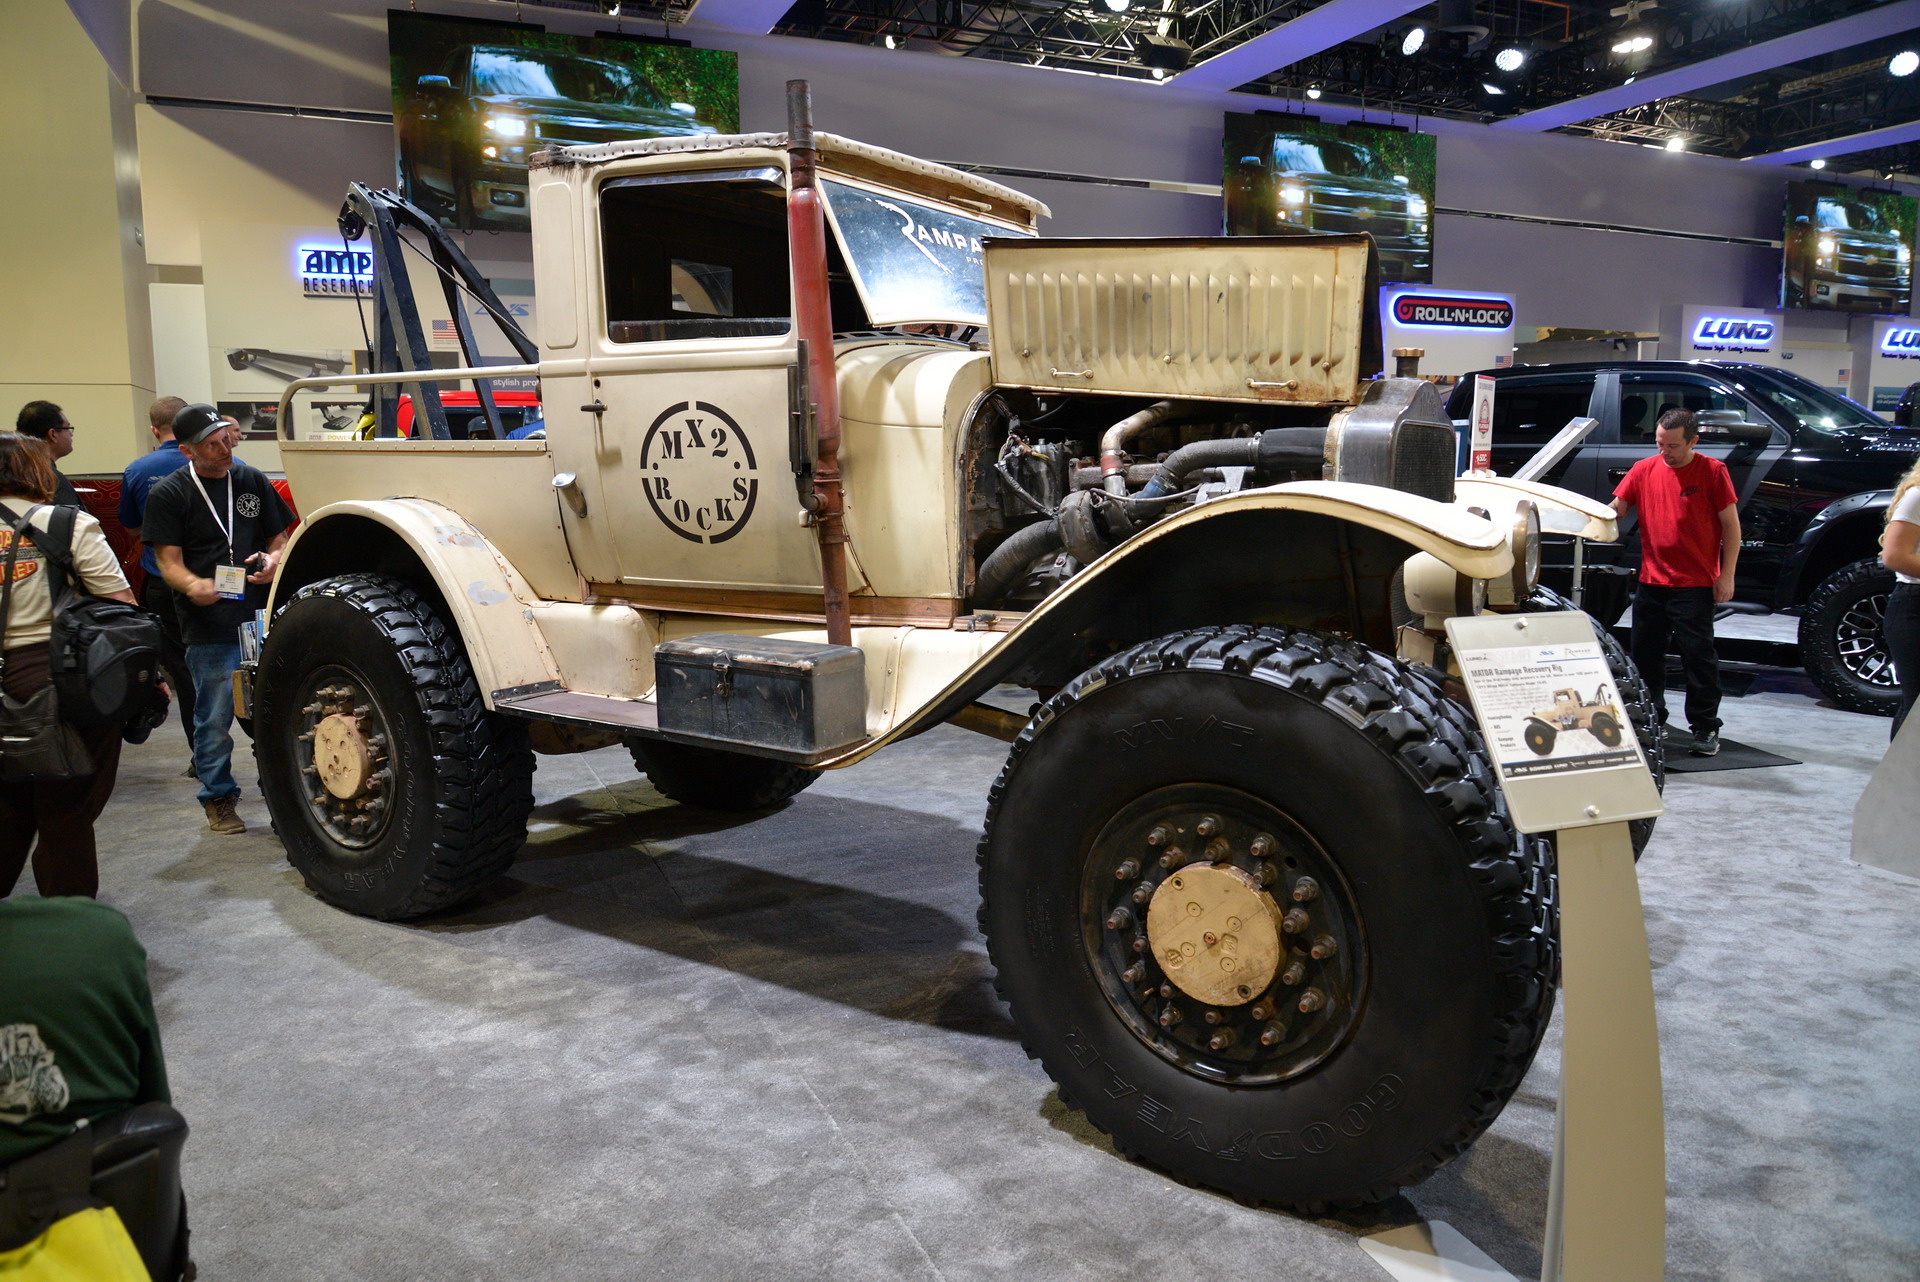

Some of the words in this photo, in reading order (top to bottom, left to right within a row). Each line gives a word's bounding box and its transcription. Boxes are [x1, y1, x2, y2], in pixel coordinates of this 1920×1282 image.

[304, 249, 373, 275] AMP
[303, 277, 374, 294] RESEARCH
[1699, 320, 1775, 340] LUND
[493, 378, 520, 388] stylish
[659, 419, 729, 459] MX2
[653, 476, 748, 530] ROCKS
[1494, 667, 1522, 676] Rampage
[1522, 665, 1552, 674] Recovery
[1551, 664, 1563, 672] Rig
[1063, 1026, 1405, 1162] GOODYEAR
